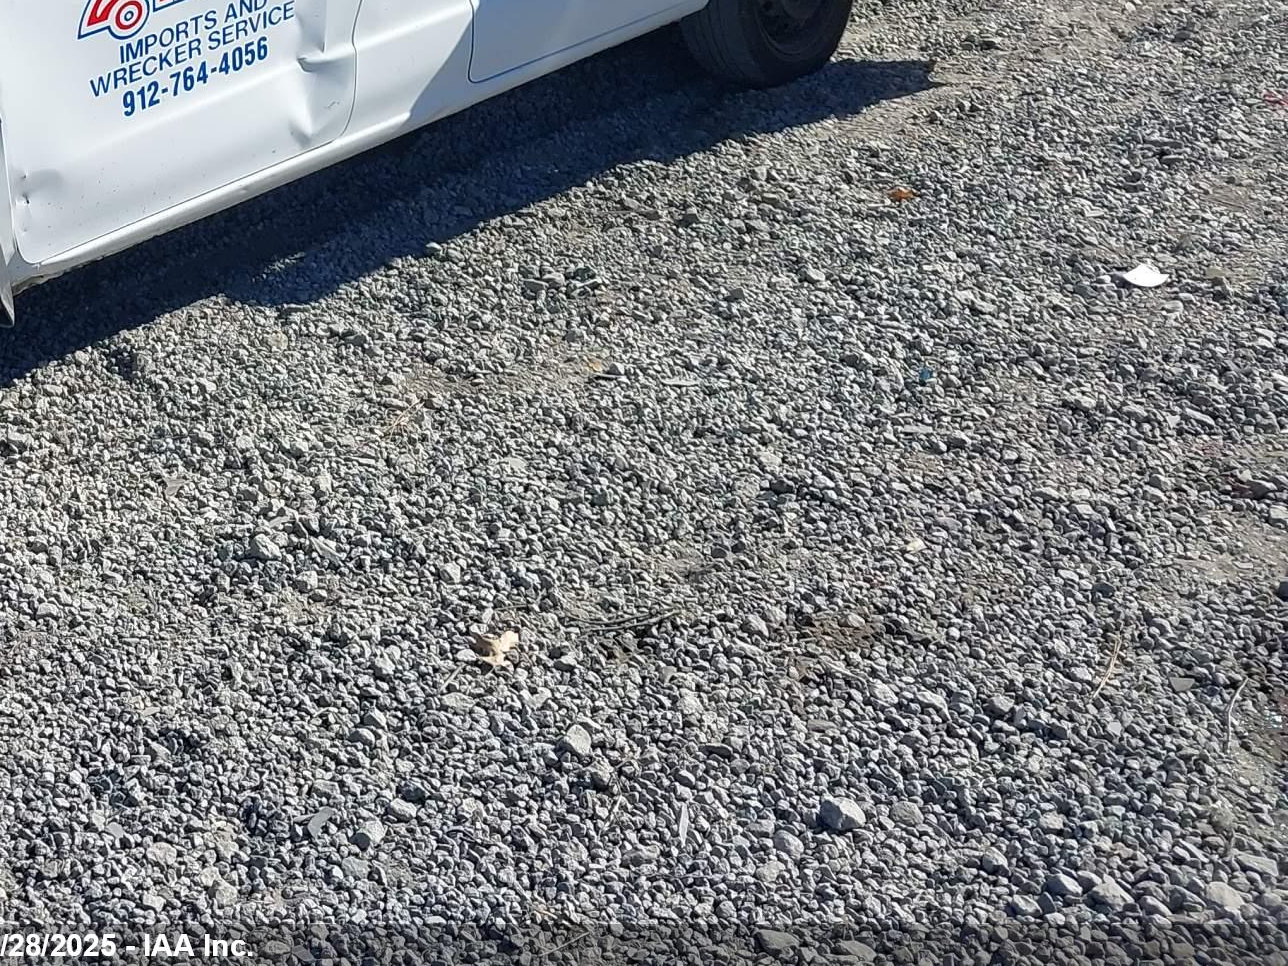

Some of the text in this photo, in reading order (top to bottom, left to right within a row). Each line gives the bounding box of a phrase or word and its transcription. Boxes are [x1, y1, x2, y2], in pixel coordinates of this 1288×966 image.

[89, 0, 295, 97] WRECKER SERVICE
[119, 11, 218, 64] IMPORTS
[122, 36, 268, 117] 912-764-4056
